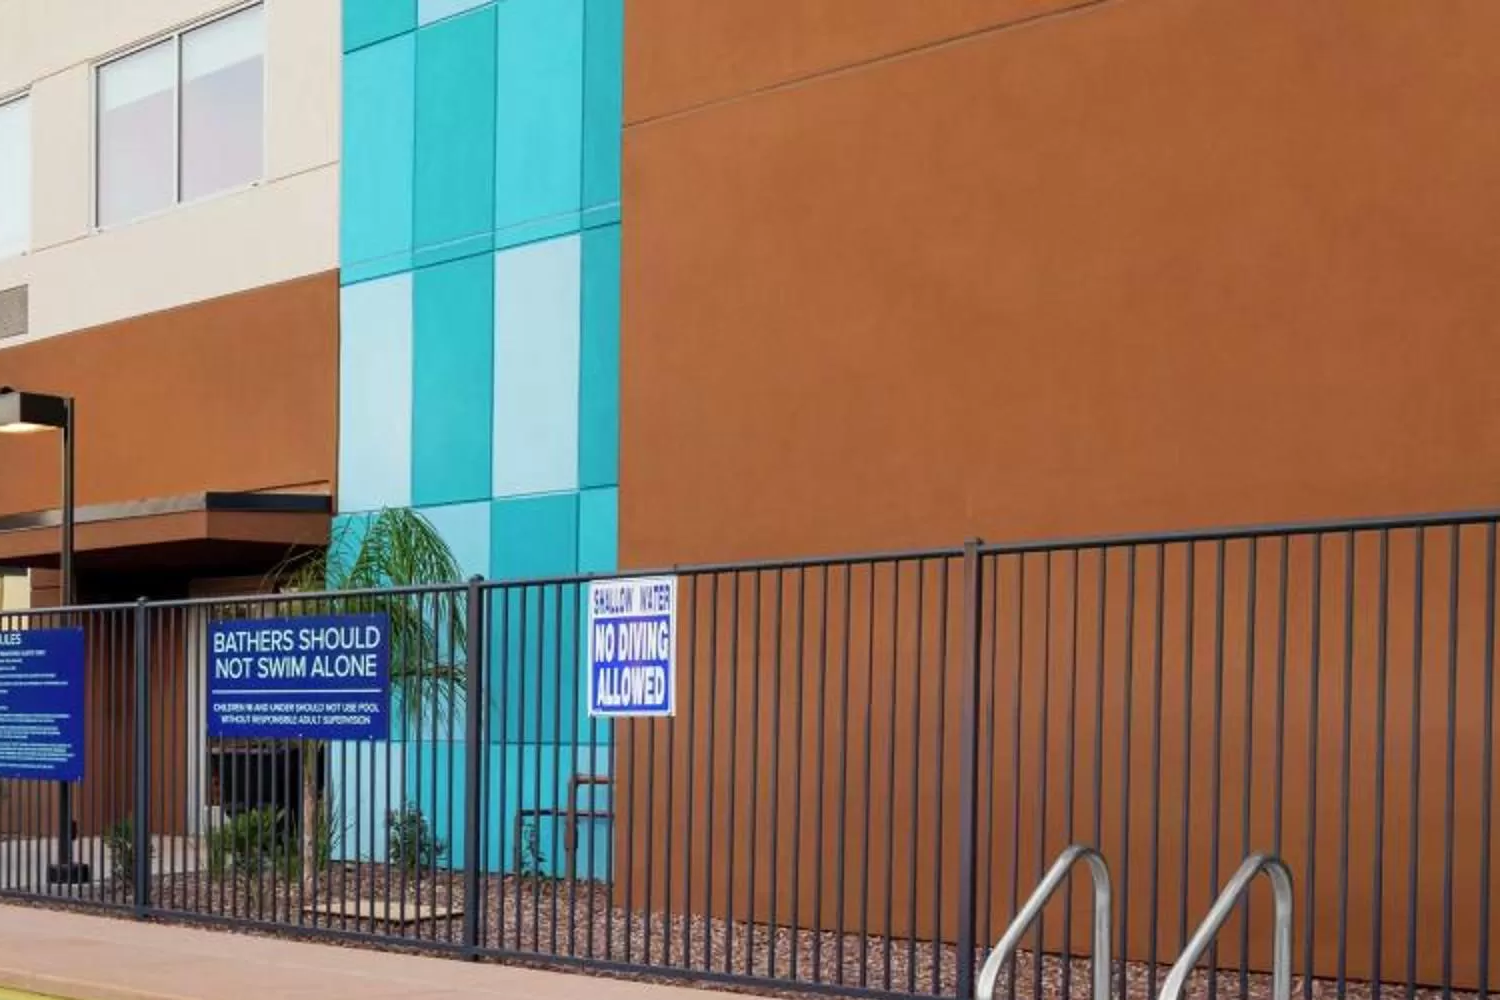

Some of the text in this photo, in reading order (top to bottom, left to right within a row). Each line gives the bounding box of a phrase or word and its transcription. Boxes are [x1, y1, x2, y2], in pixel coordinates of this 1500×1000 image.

[594, 584, 671, 614] SHALLOW WATER
[213, 626, 381, 653] BATHERS SHOULD
[595, 621, 669, 662] NO DIVING
[215, 654, 378, 679] NOT SWIM ALONE
[597, 666, 666, 706] ALLOWED
[221, 715, 251, 725] WITHOUT
[298, 715, 321, 725] ADULT
[269, 703, 295, 713] UNDER
[295, 703, 325, 713] SHOULD
[325, 703, 341, 713] NOT
[342, 703, 356, 713] USE
[358, 702, 380, 713] POOL
